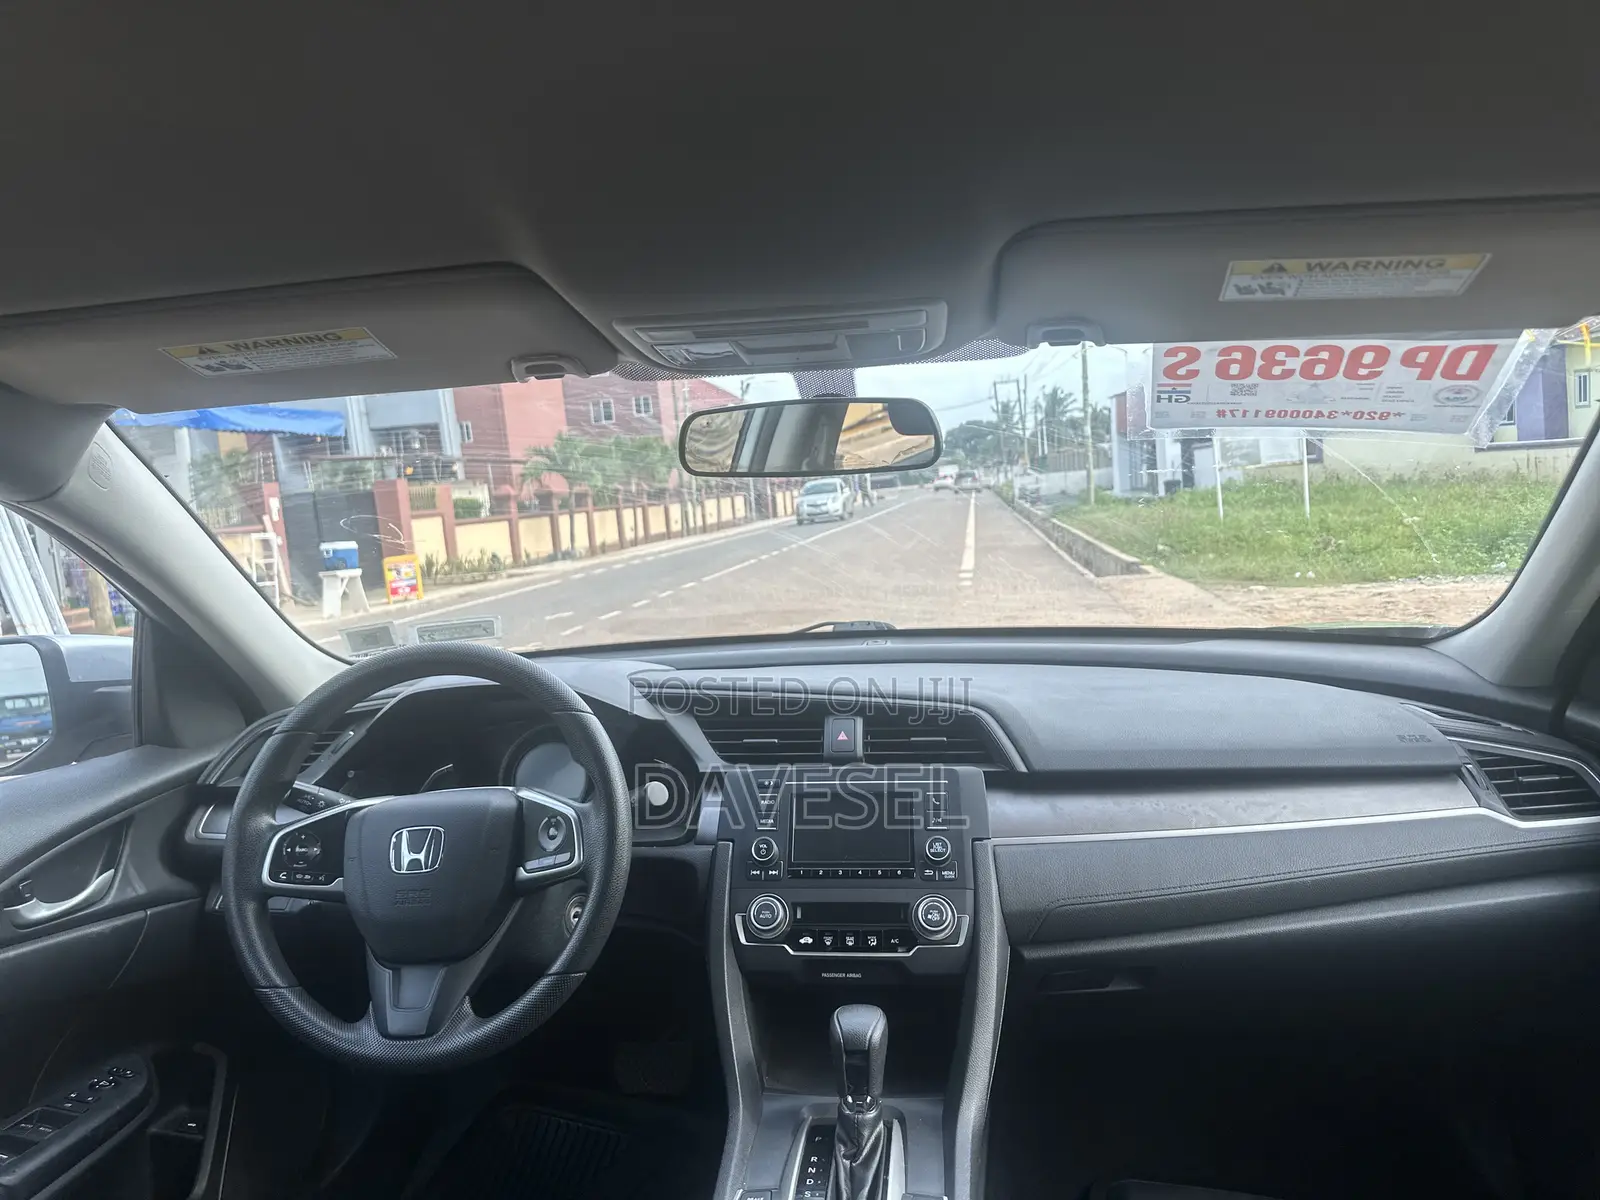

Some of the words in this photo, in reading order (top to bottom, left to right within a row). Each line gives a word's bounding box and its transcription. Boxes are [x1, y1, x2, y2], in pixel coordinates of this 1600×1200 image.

[1305, 257, 1448, 273] WARNING
[227, 331, 343, 352] WARNING
[803, 1190, 812, 1198] S
